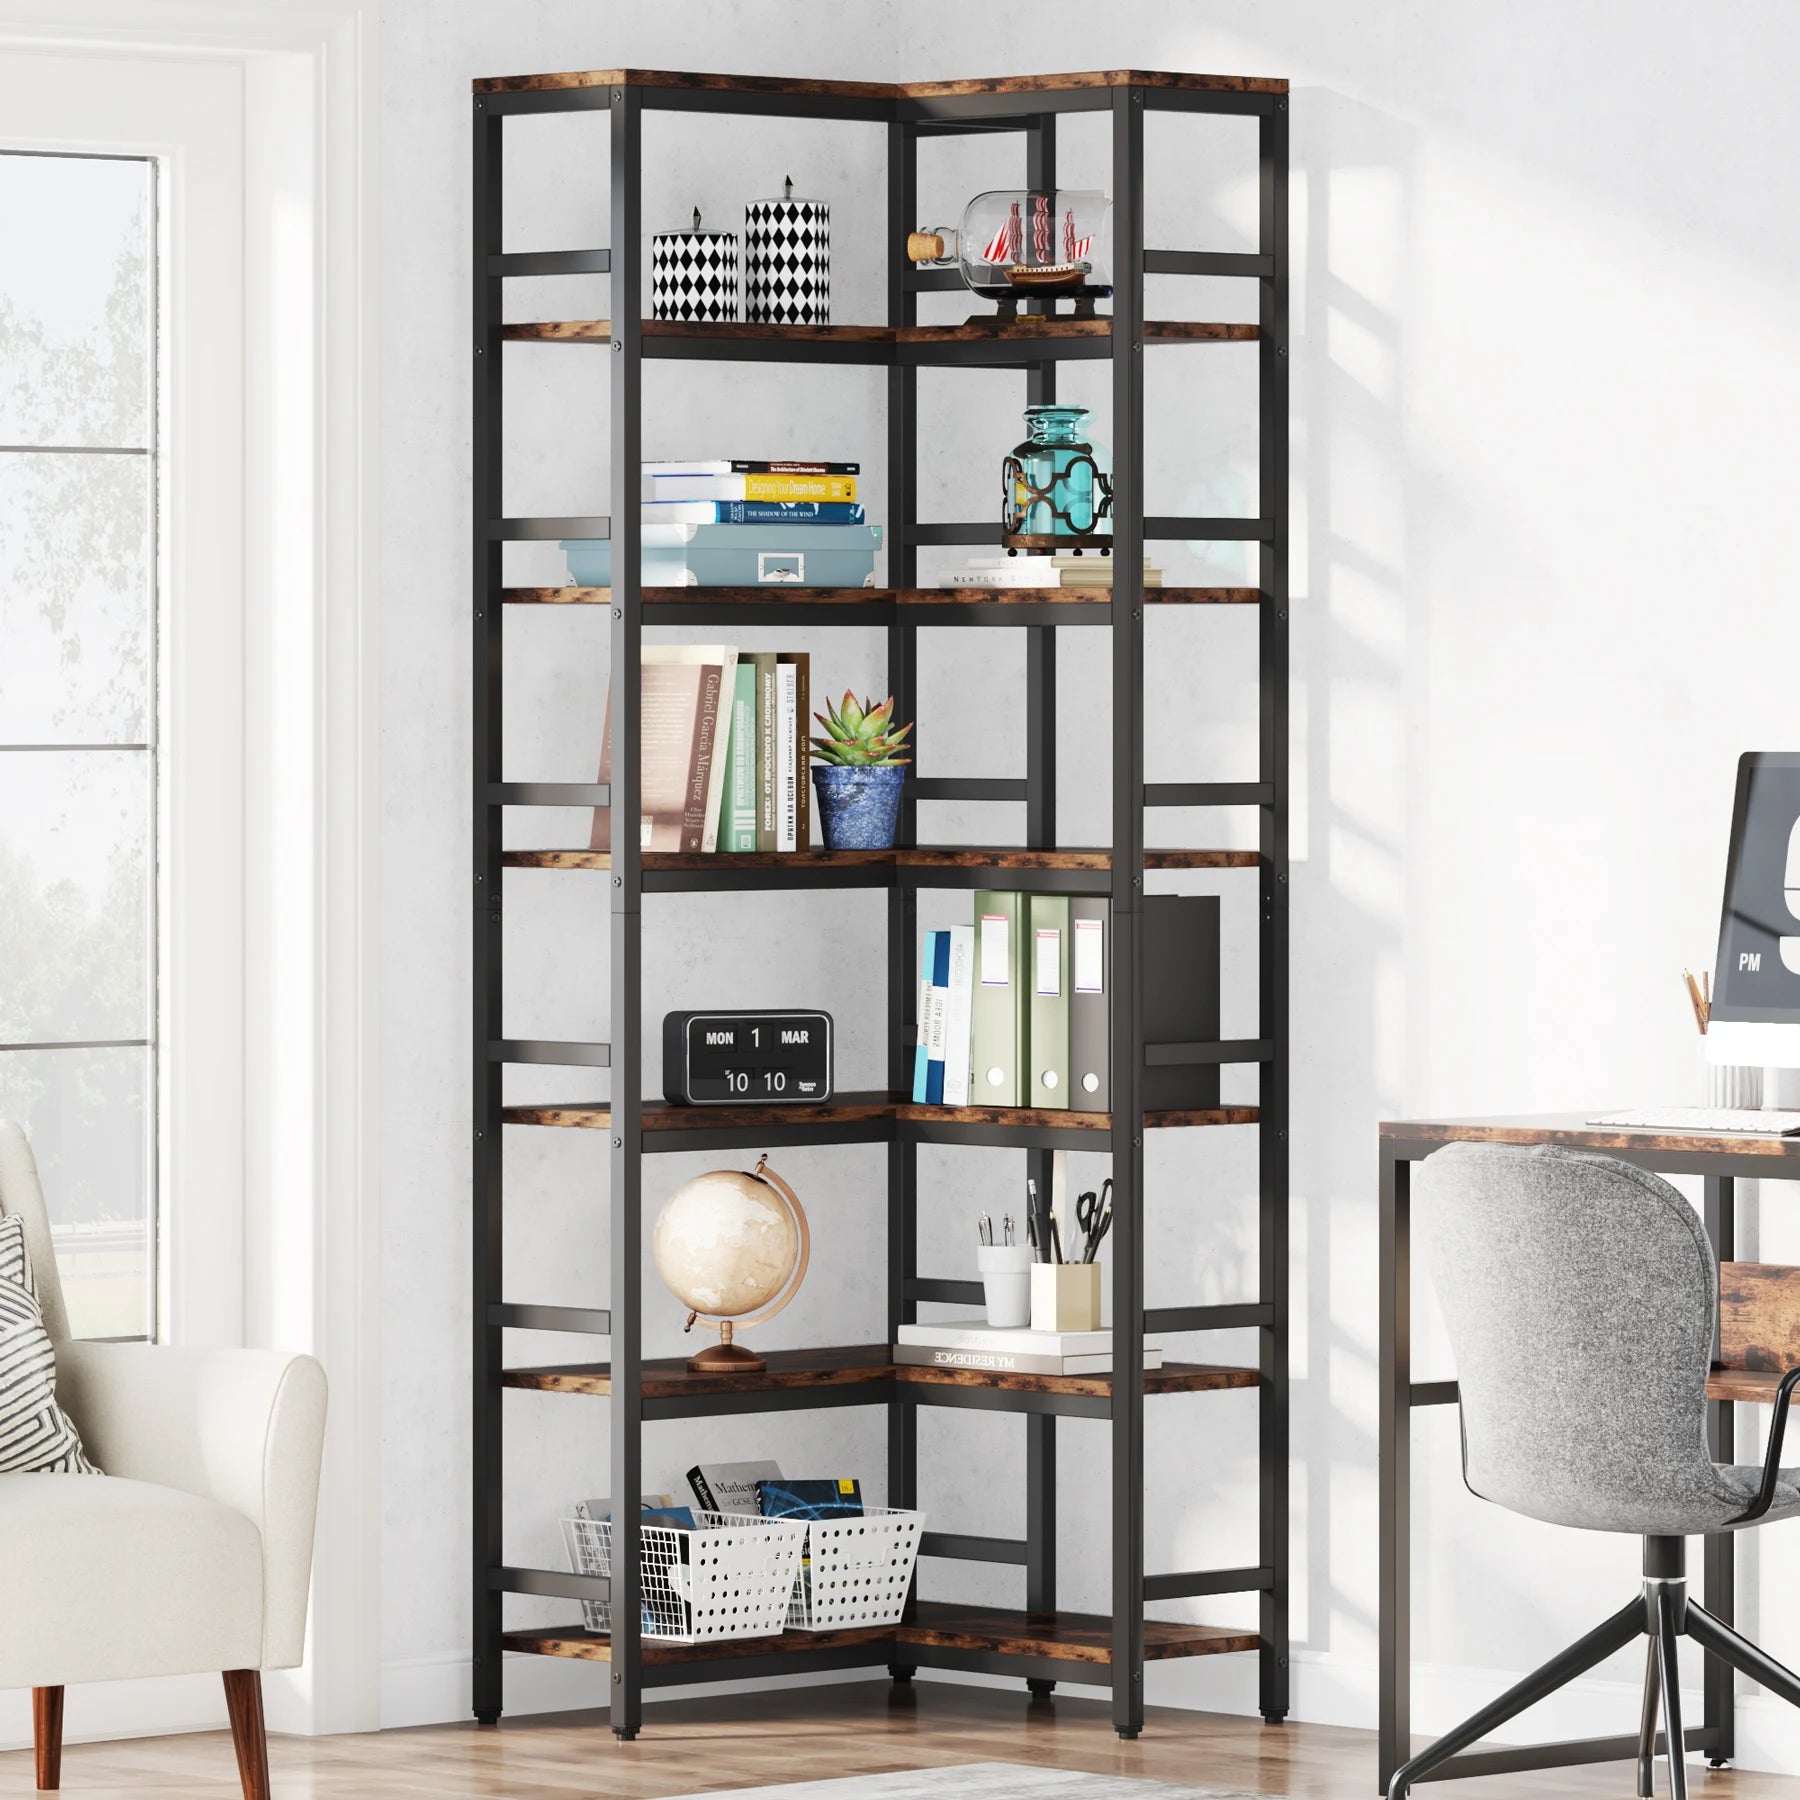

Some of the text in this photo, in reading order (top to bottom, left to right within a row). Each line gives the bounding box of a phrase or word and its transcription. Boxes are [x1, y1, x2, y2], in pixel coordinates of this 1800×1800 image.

[748, 479, 777, 498] Designing
[777, 480, 789, 494] Your
[790, 480, 808, 495] Dream
[808, 481, 826, 496] Home
[764, 673, 772, 726] СЛОЖНОМУ
[693, 674, 719, 800] Gabriel García Márquez
[764, 736, 772, 780] ПРОСТОГО
[764, 782, 772, 794] ОТ
[786, 776, 794, 801] ОСЕВОЙ
[764, 797, 772, 831] FOREX:
[787, 804, 794, 813] НА
[1738, 953, 1761, 972] PM
[706, 1027, 809, 1048] MON 1 MAR
[726, 1072, 749, 1092] 10
[763, 1072, 786, 1091] 10
[694, 1475, 713, 1510] Mathem
